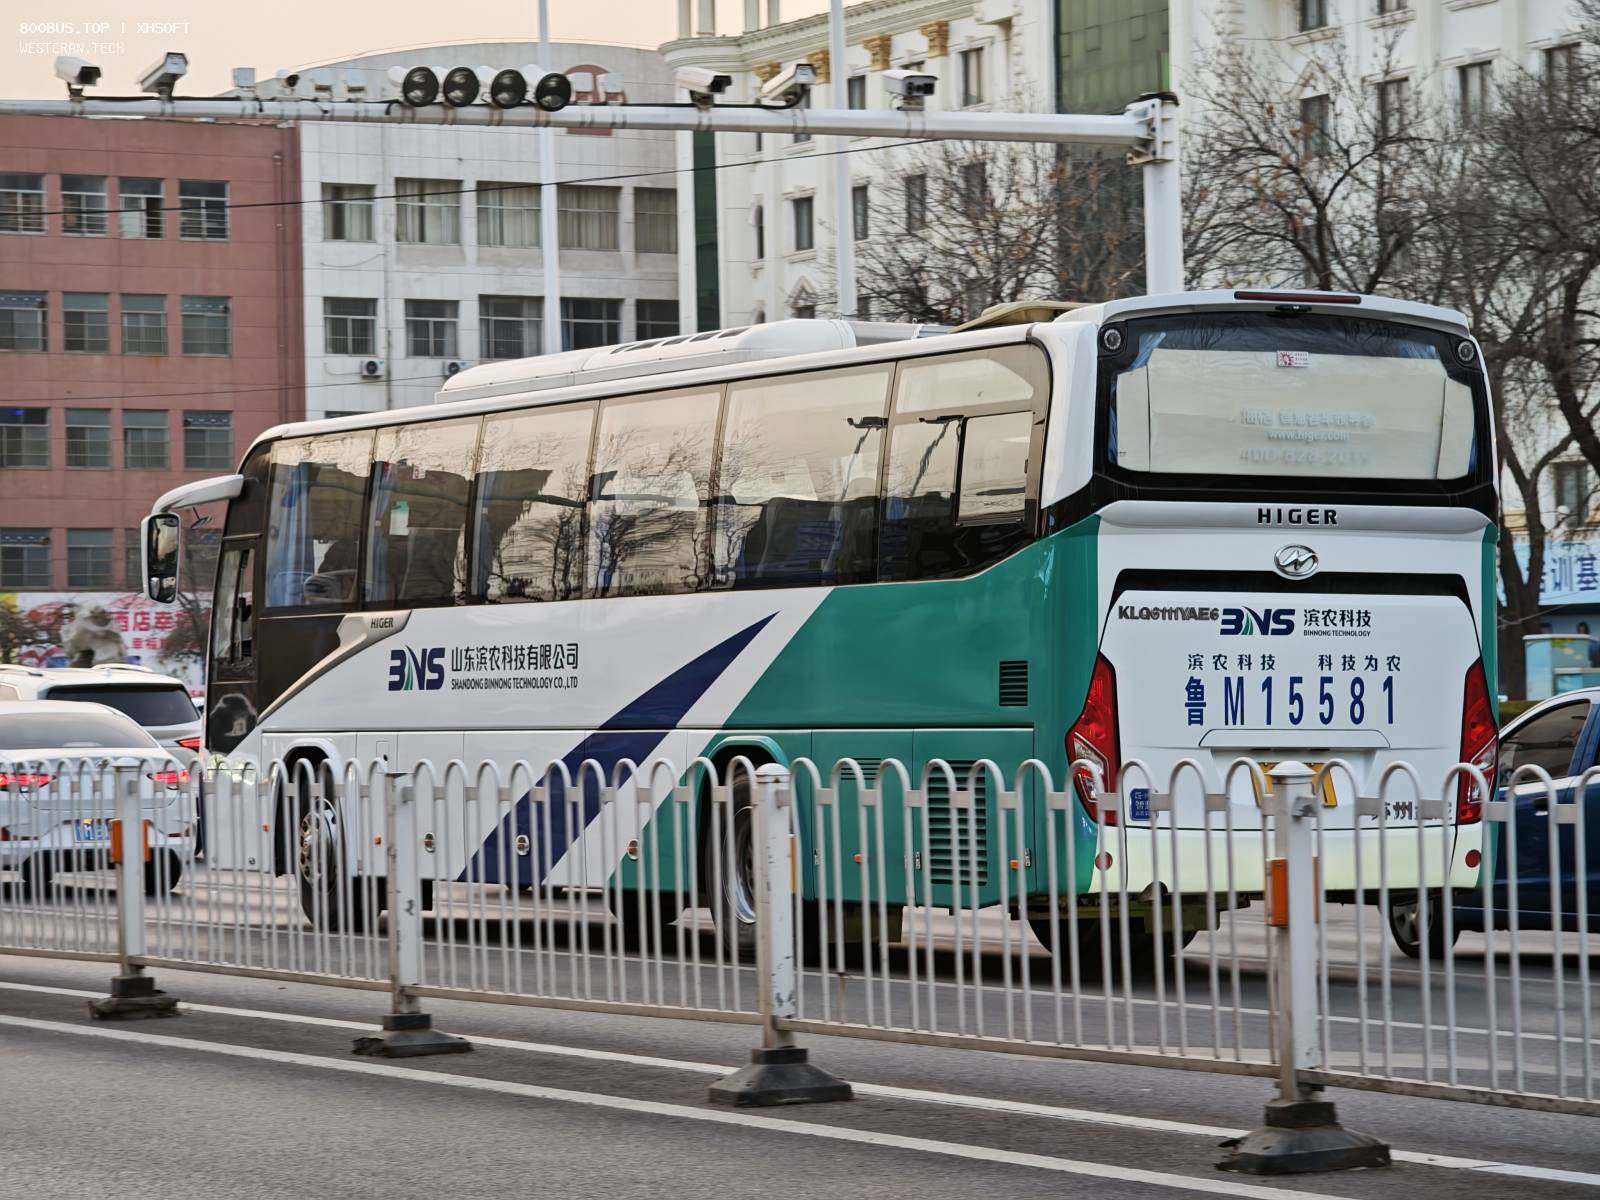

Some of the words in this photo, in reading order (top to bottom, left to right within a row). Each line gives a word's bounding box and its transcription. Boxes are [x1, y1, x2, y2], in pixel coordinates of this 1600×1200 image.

[1258, 508, 1337, 525] HIGER
[370, 617, 394, 629] HIGER
[1220, 605, 1296, 636] BNS
[1303, 608, 1372, 628] 滨农科技
[1303, 629, 1331, 637] BINNONG
[1332, 630, 1371, 638] TECHNOLOGY
[451, 643, 579, 672] 山东滨农科技有限公司
[1187, 654, 1276, 671] 滨农科技
[1317, 654, 1401, 672] 科技为农
[388, 645, 446, 691] BNS
[451, 678, 484, 691] SHANDONG
[484, 677, 512, 690] BINNONG
[512, 676, 553, 689] TECHNOLOGY
[553, 676, 578, 690] CO.,LTD
